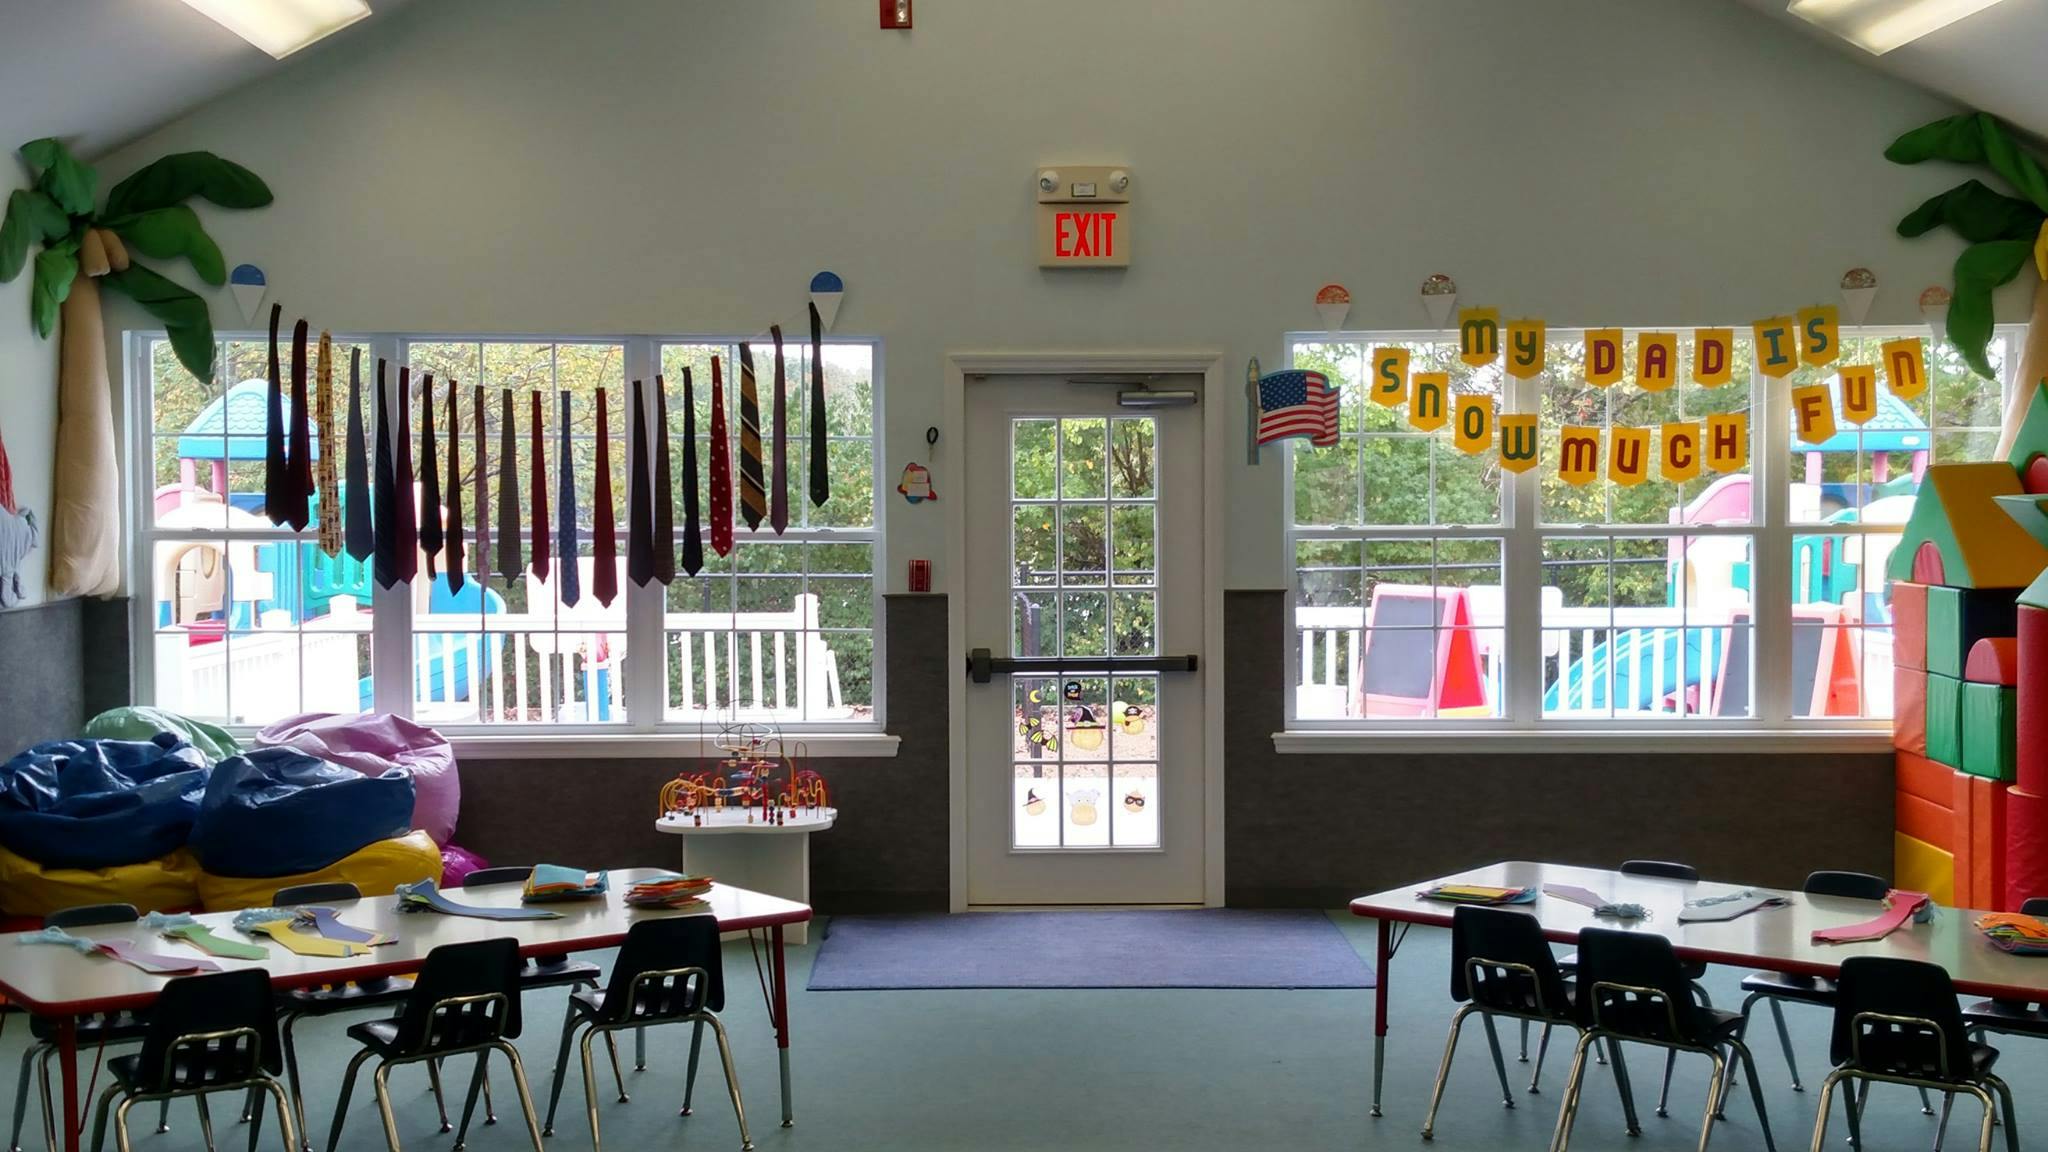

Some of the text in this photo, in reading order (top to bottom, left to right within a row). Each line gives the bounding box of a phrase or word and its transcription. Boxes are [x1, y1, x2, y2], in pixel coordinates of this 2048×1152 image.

[1056, 212, 1117, 257] EXIT
[1461, 318, 1828, 379] MY DAD IS
[1380, 350, 1918, 475] SNOW MUCH FUN
